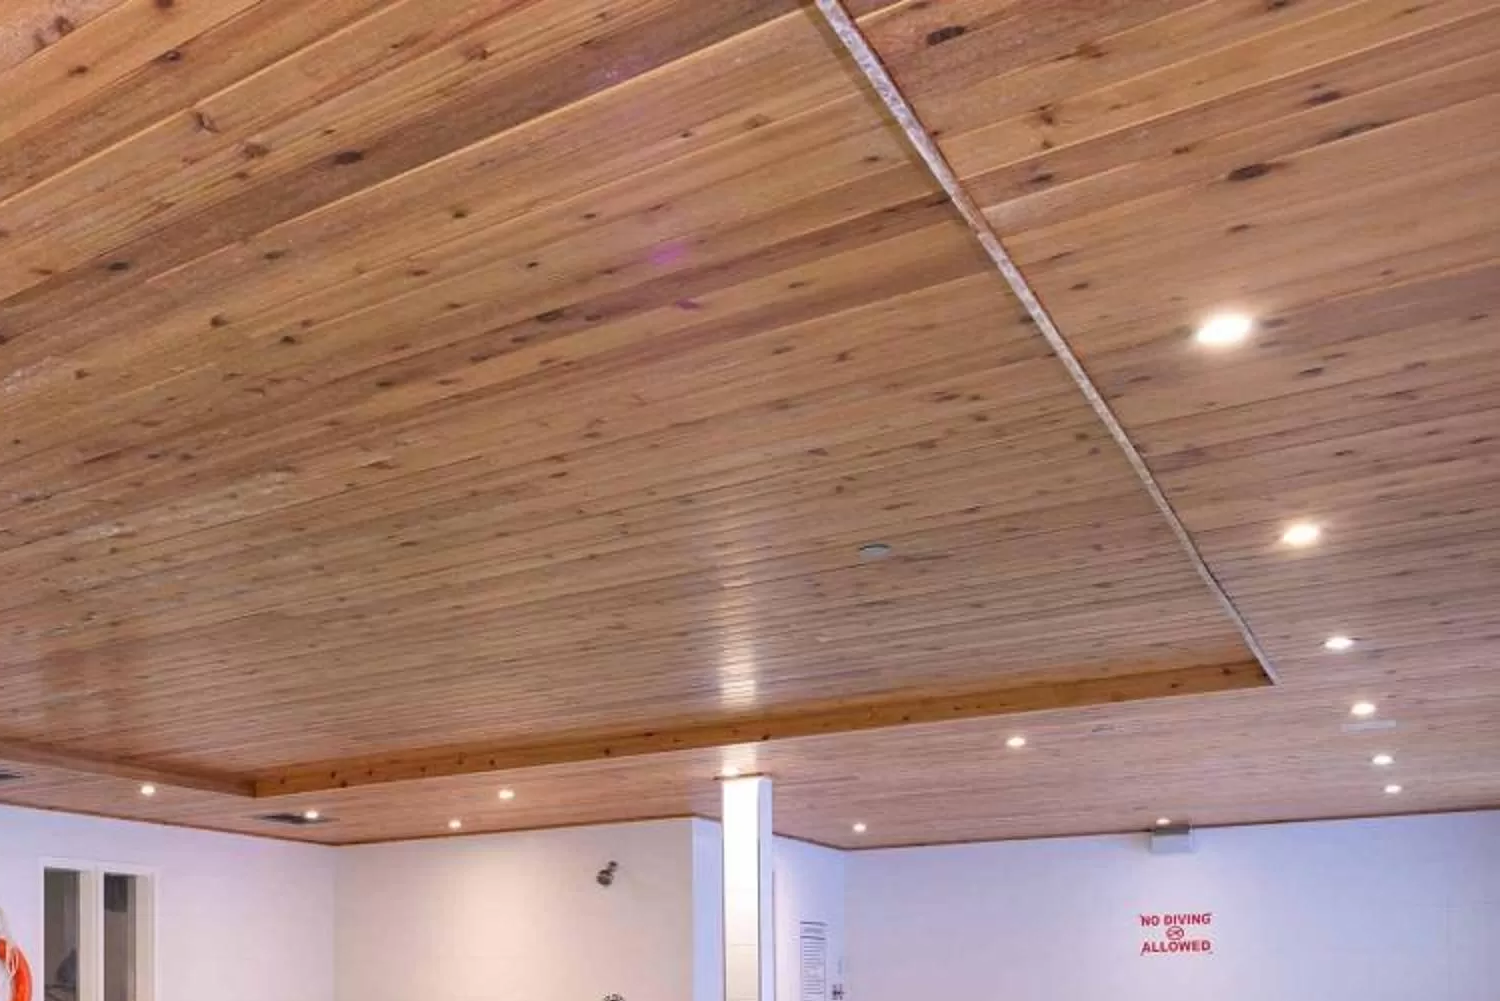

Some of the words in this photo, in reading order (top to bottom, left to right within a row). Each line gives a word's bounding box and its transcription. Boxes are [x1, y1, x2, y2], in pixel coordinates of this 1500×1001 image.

[1140, 914, 1160, 926] NO
[1164, 912, 1212, 925] DIVING
[1140, 940, 1213, 955] ALLOWED
